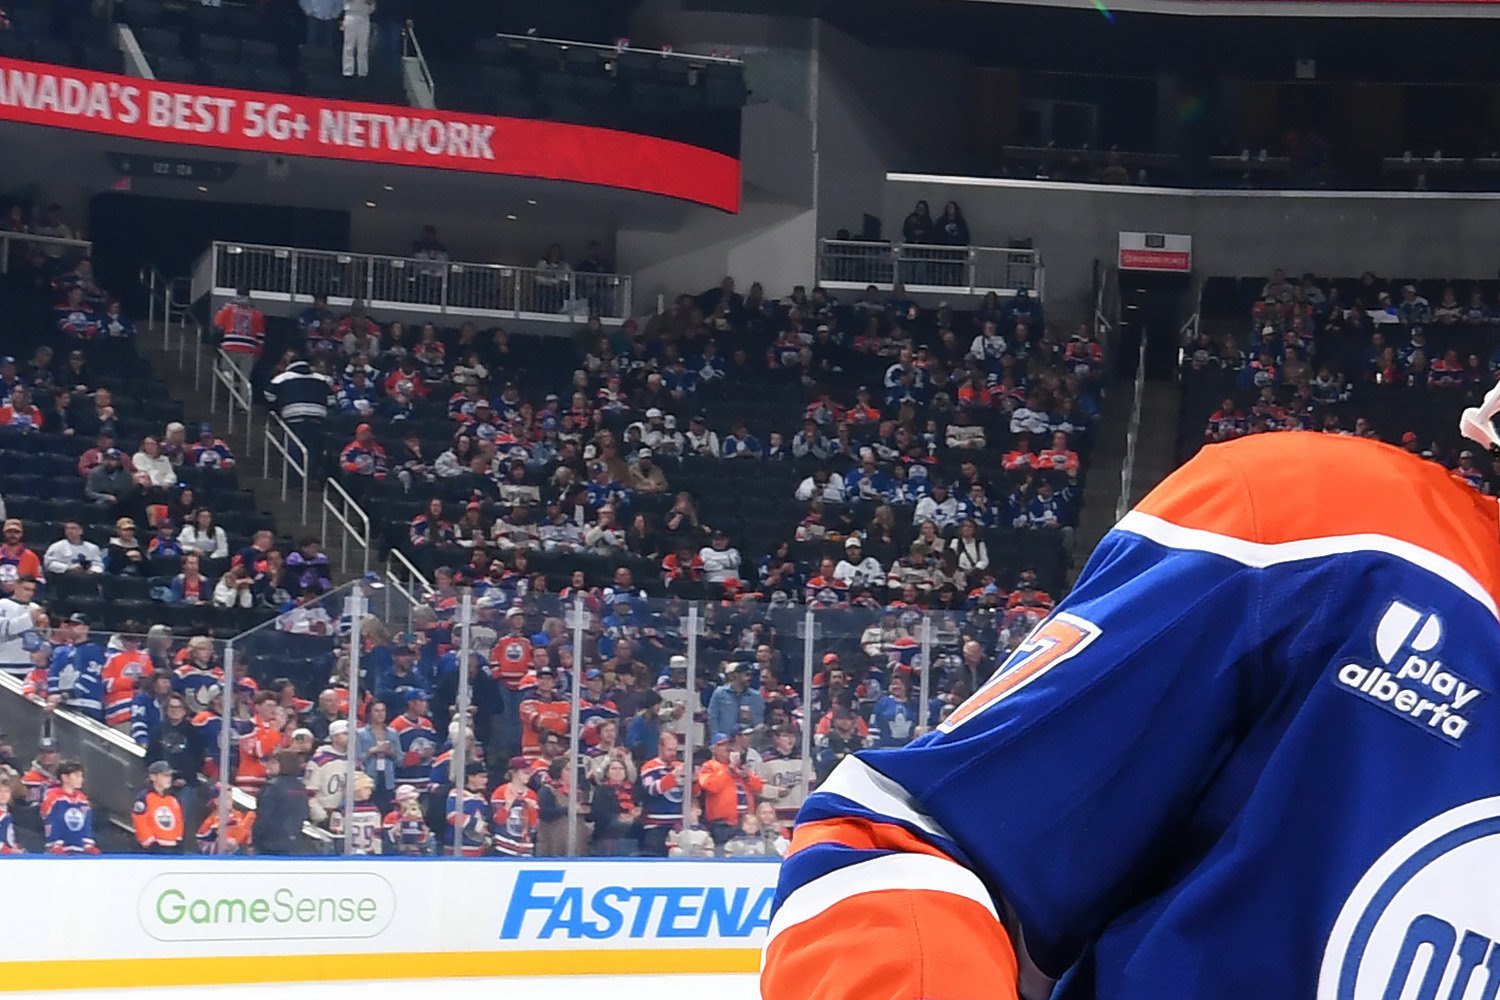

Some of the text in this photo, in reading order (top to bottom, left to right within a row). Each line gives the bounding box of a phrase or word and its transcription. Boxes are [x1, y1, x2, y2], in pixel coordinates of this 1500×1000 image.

[147, 90, 236, 133] BEST
[243, 101, 310, 141] 5G+
[318, 108, 496, 160] NETWORK
[1338, 663, 1470, 739] alberta
[1396, 655, 1481, 709] play
[156, 888, 377, 924] GameSense
